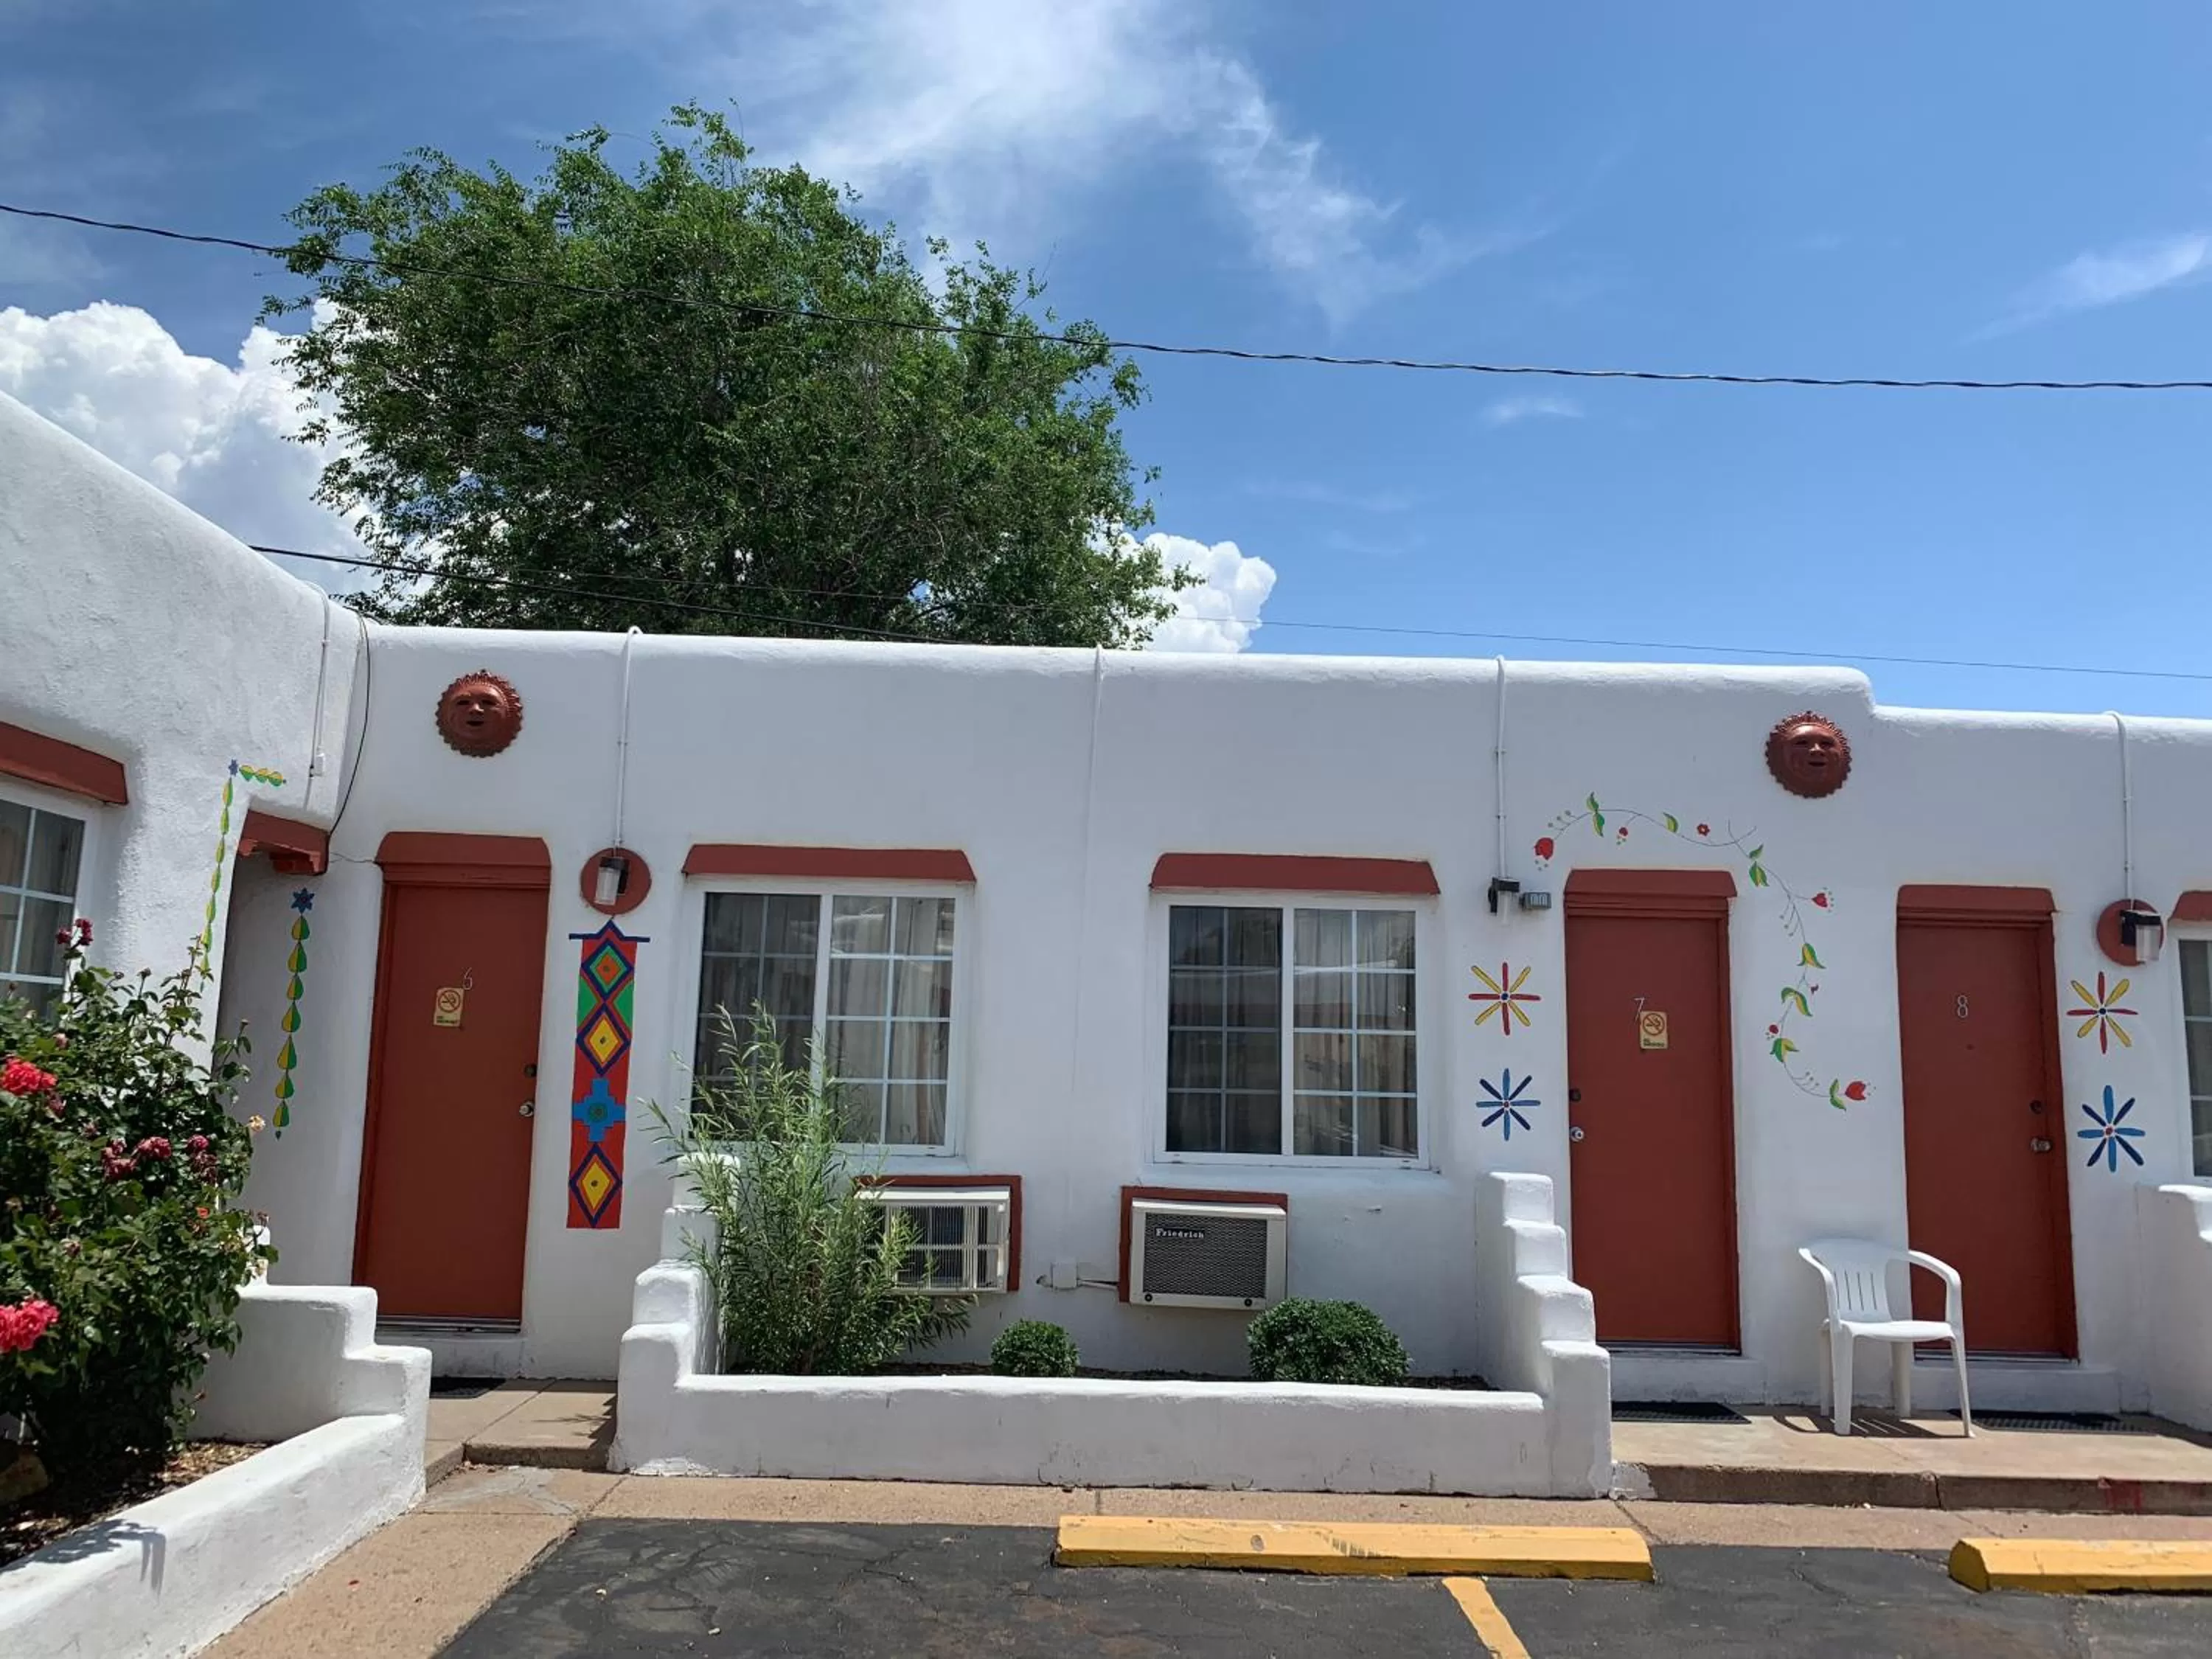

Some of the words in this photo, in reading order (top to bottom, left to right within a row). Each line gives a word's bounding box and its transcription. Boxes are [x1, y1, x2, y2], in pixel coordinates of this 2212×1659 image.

[463, 967, 473, 990] 6
[1634, 997, 1645, 1023] 7
[1958, 995, 1968, 1018] 8
